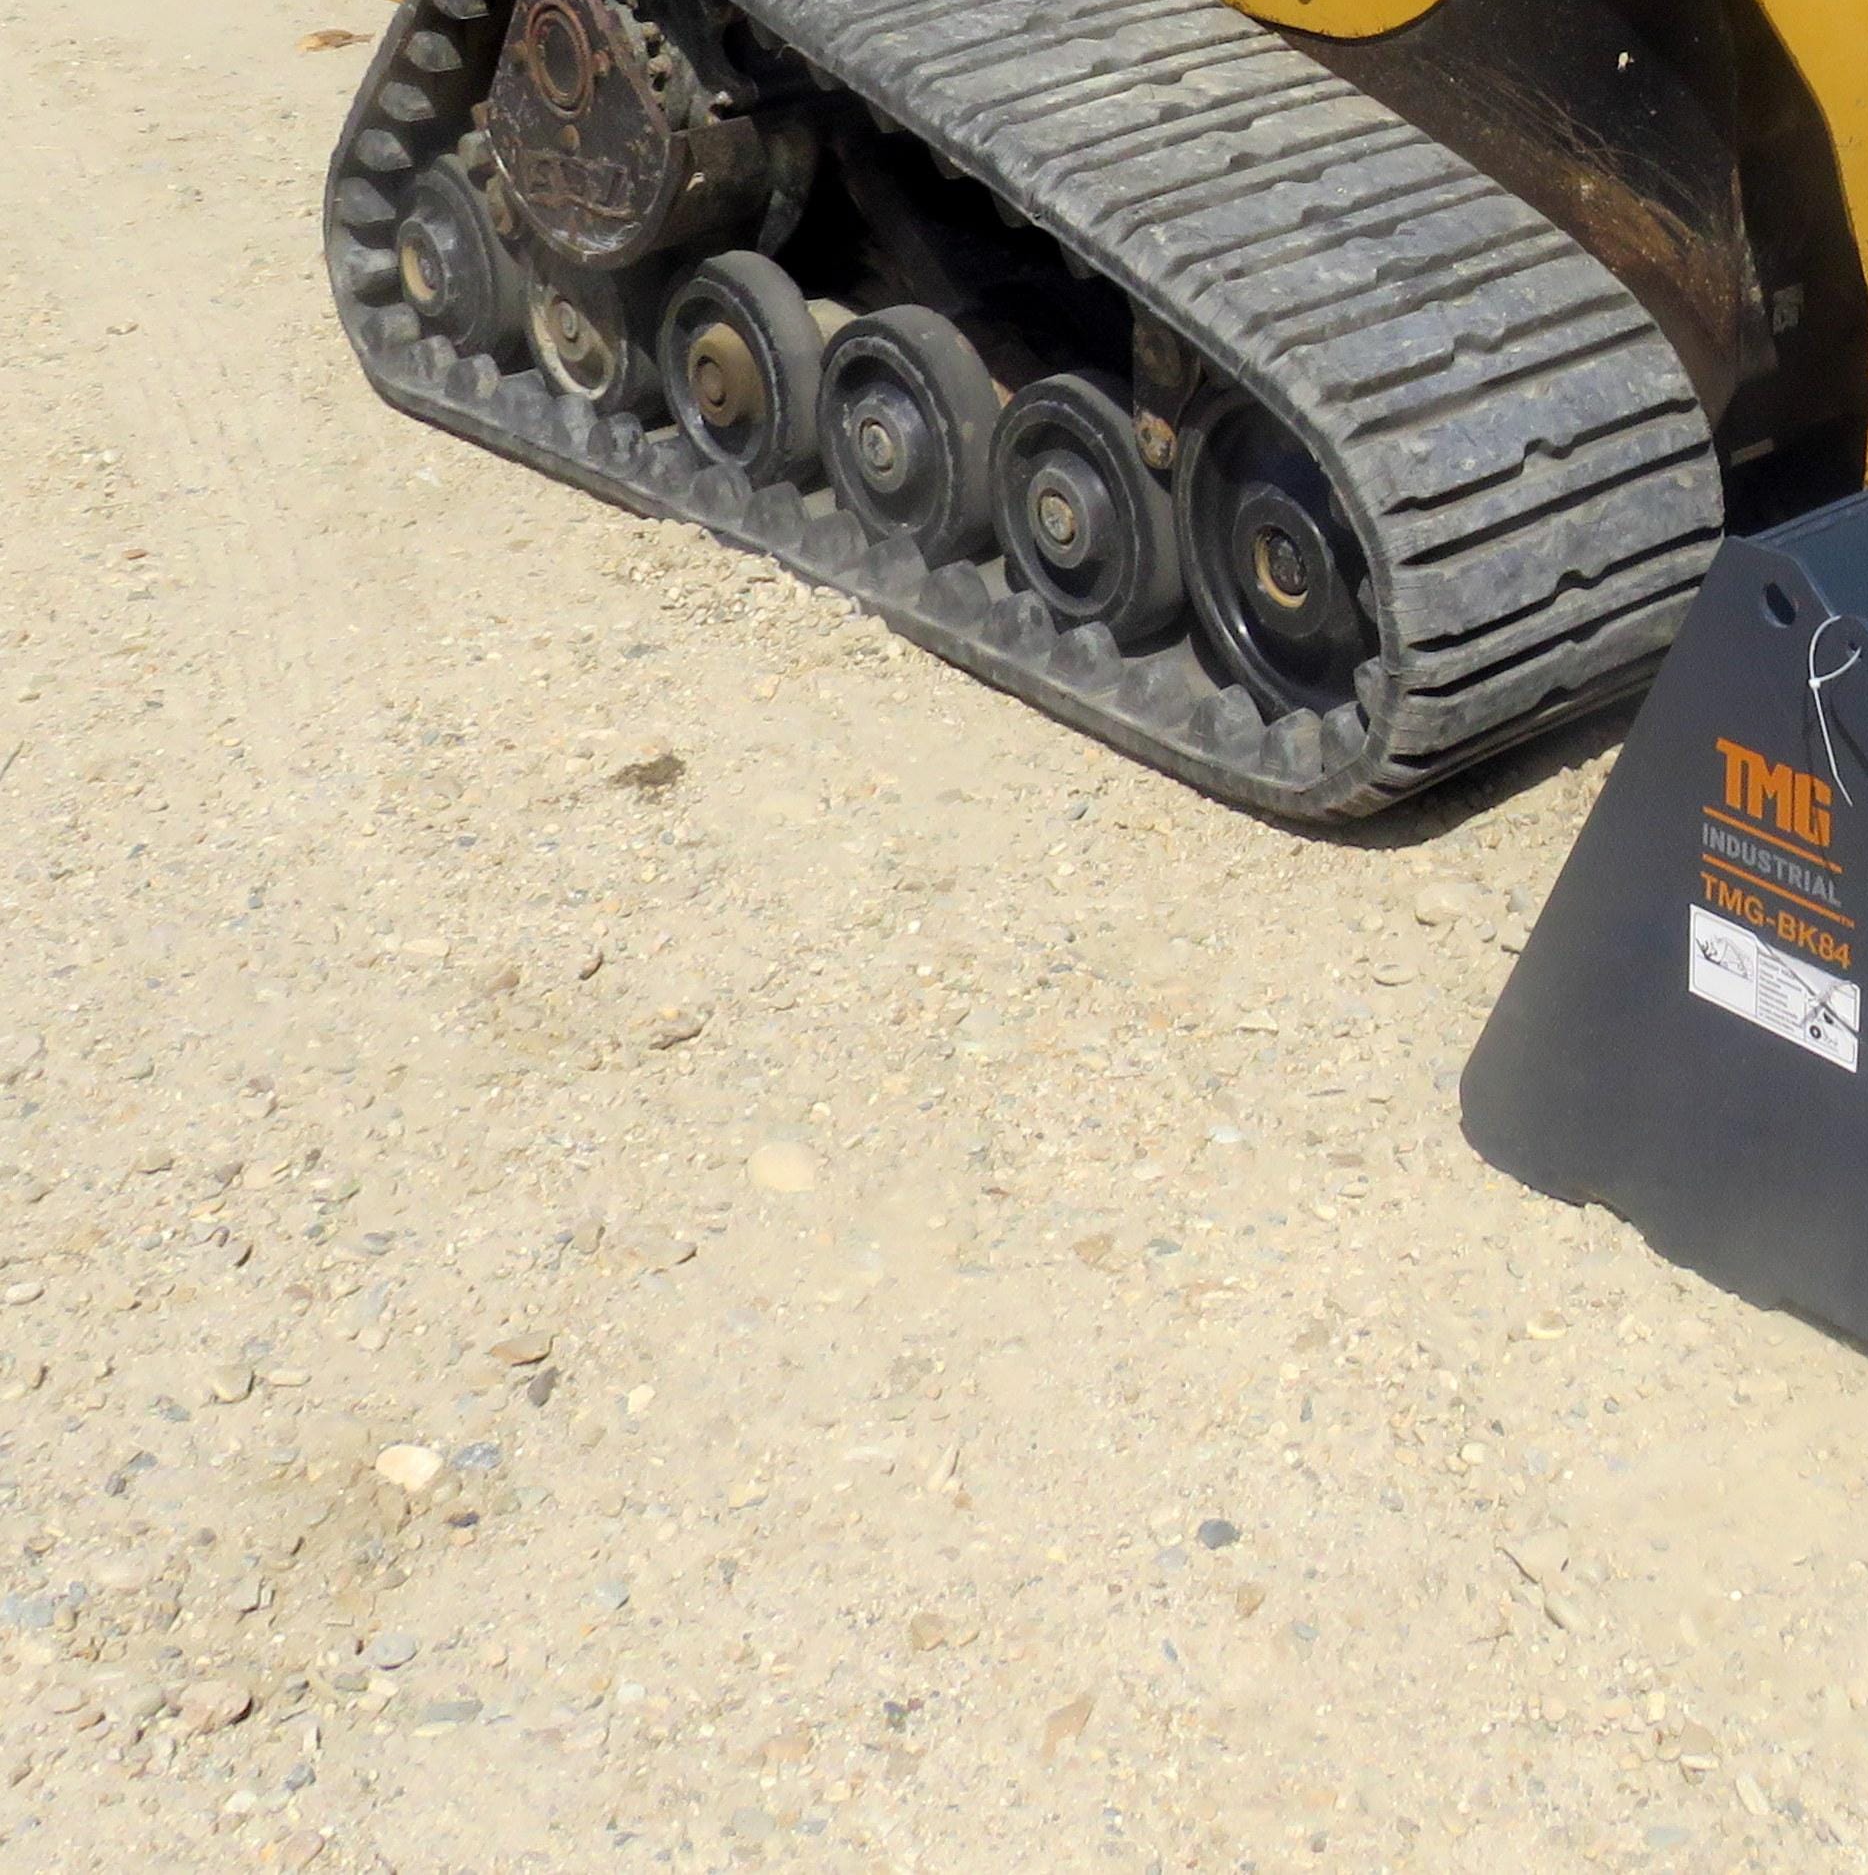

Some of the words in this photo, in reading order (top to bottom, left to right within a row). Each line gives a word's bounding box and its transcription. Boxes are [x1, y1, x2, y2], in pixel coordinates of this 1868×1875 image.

[1715, 737, 1834, 847] TMG
[1702, 822, 1842, 908] INDUSTRIAL
[1700, 871, 1853, 971] TMG-BK84
